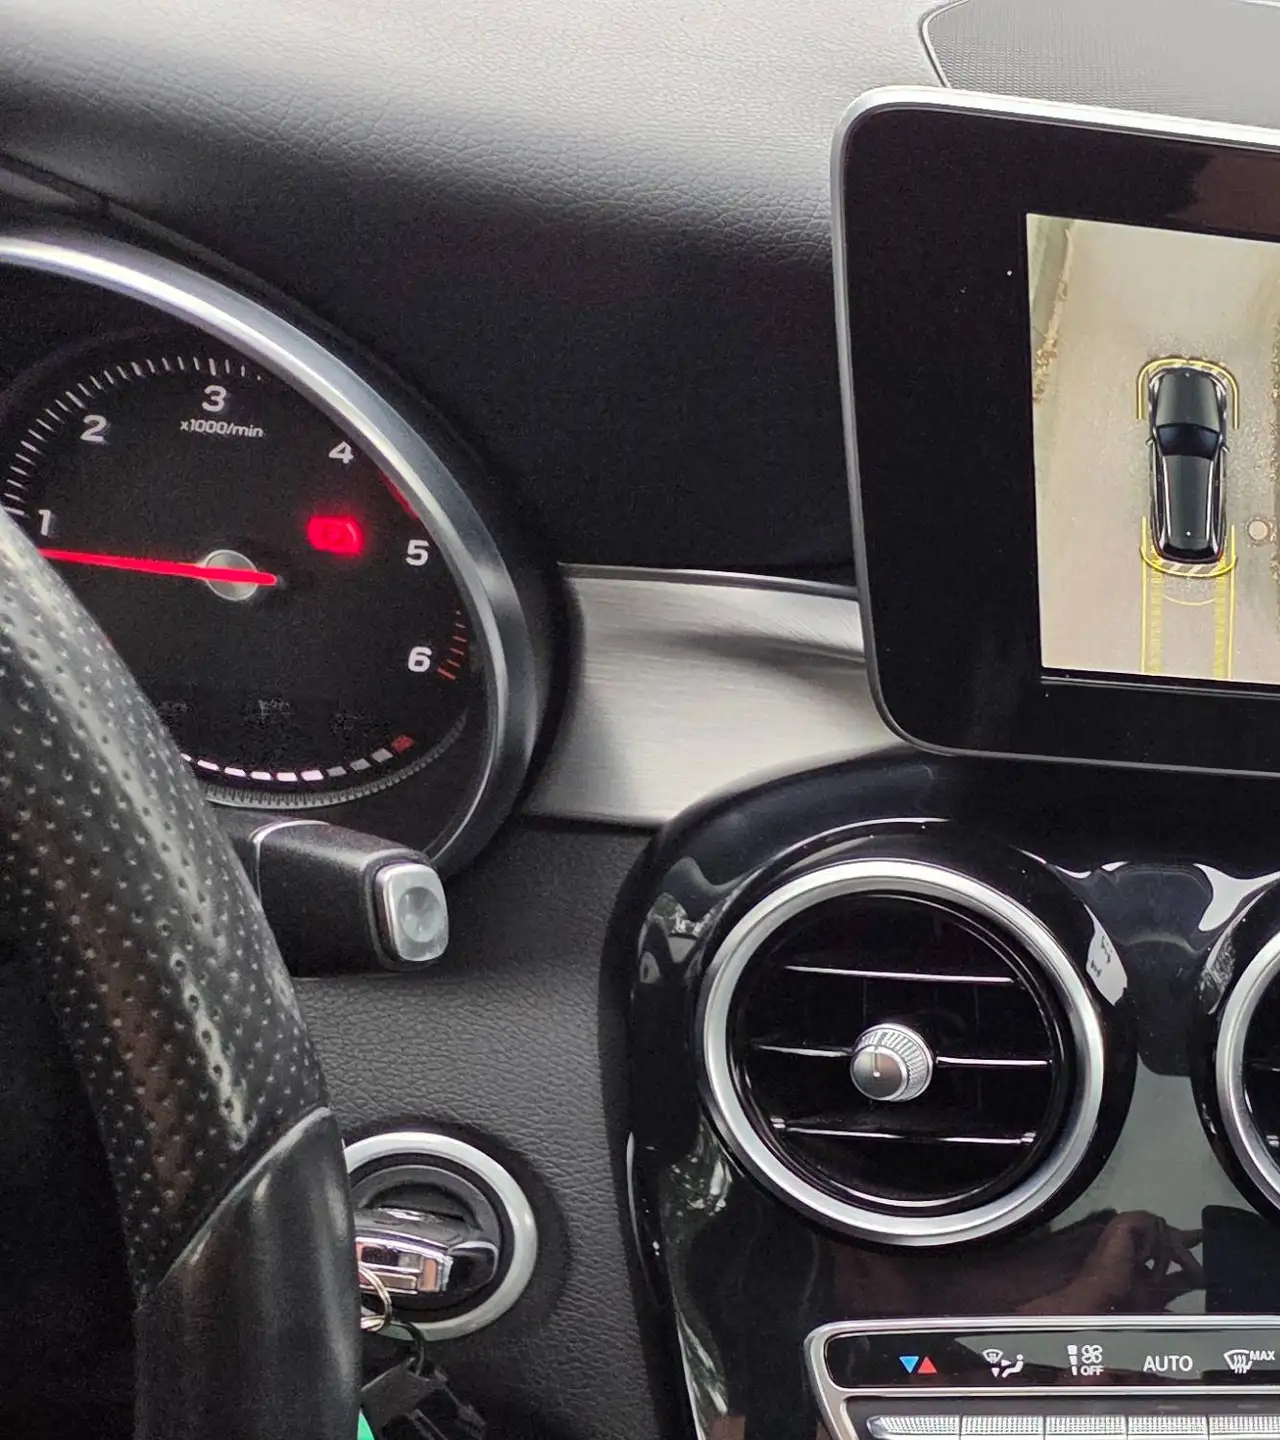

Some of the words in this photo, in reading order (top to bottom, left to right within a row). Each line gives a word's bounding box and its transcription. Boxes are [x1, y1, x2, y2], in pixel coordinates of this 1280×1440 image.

[201, 384, 226, 413] 3
[80, 415, 107, 443] 2
[180, 418, 264, 438] x1000/min
[329, 440, 353, 465] 4
[37, 508, 54, 536] 1
[405, 540, 429, 567] 5
[407, 645, 432, 673] 6
[1143, 1354, 1193, 1373] AUTO
[1250, 1349, 1276, 1362] MAX
[1080, 1364, 1105, 1376] OFF
